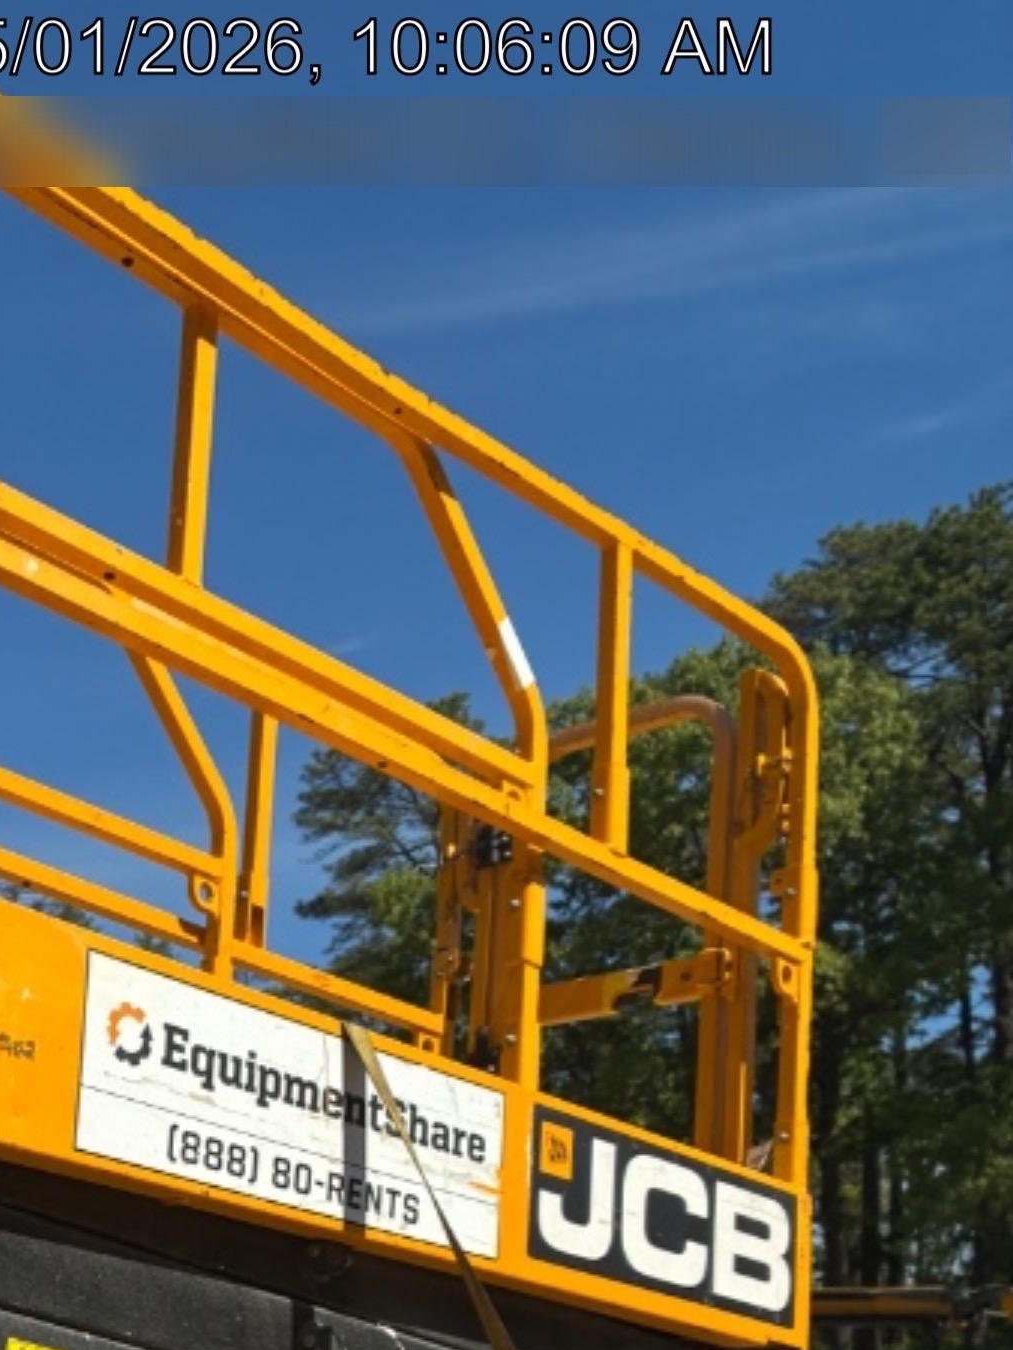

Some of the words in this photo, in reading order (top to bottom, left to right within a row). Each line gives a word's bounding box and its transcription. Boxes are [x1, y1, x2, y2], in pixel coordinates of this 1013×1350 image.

[166, 1123, 260, 1183] (888)
[271, 1156, 421, 1226] 80-RENTS
[537, 1136, 792, 1313] JCB
